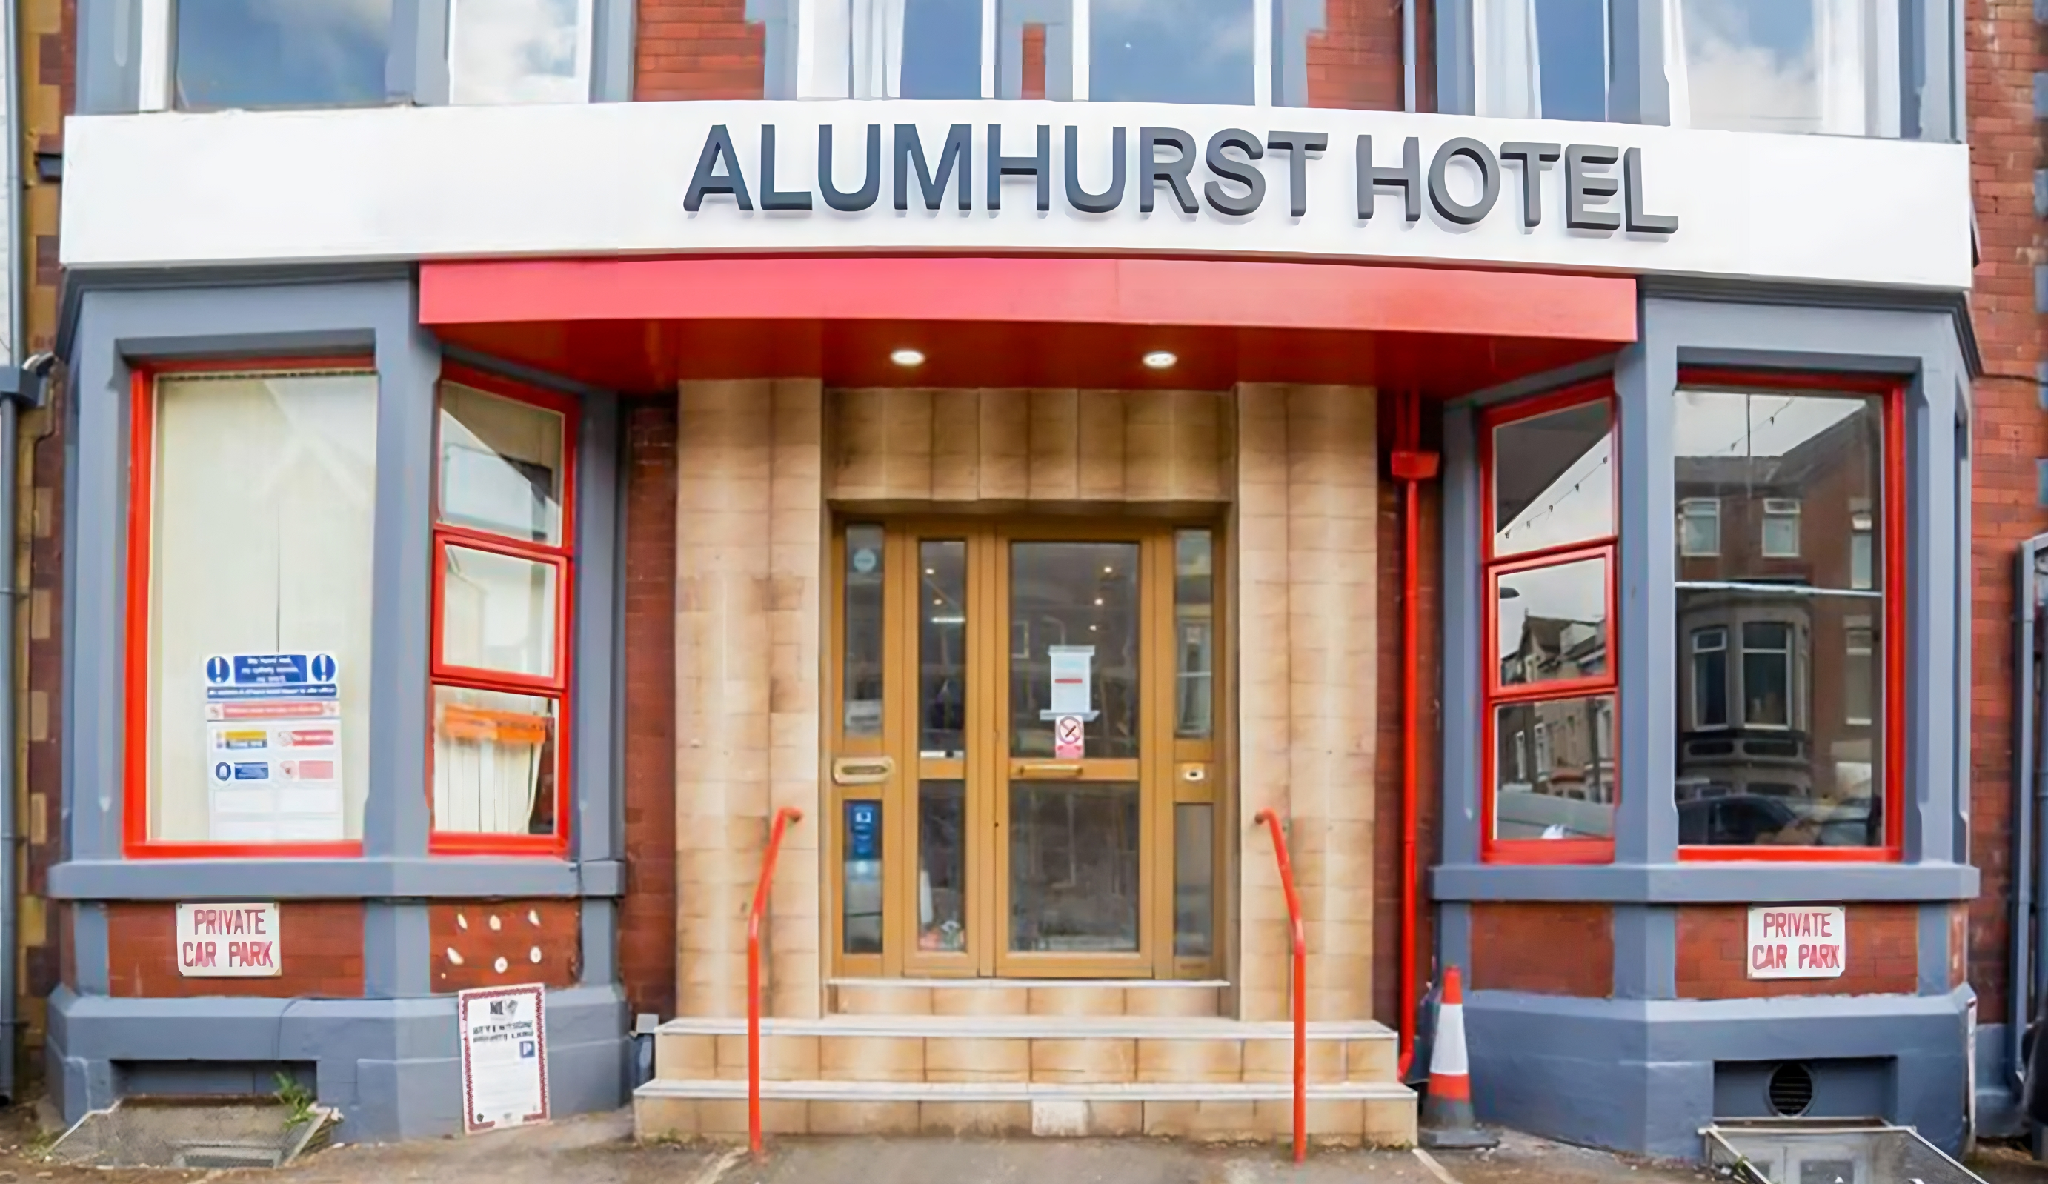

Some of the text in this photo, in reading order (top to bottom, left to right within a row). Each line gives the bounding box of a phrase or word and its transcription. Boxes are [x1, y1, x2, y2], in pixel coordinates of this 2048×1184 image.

[683, 123, 1679, 234] ALUMHURST HOTEL
[193, 909, 267, 935] PRIVATE
[1763, 912, 1833, 938] PRIVATE
[182, 940, 274, 968] CAR PARK
[1751, 943, 1840, 970] CAR PARK
